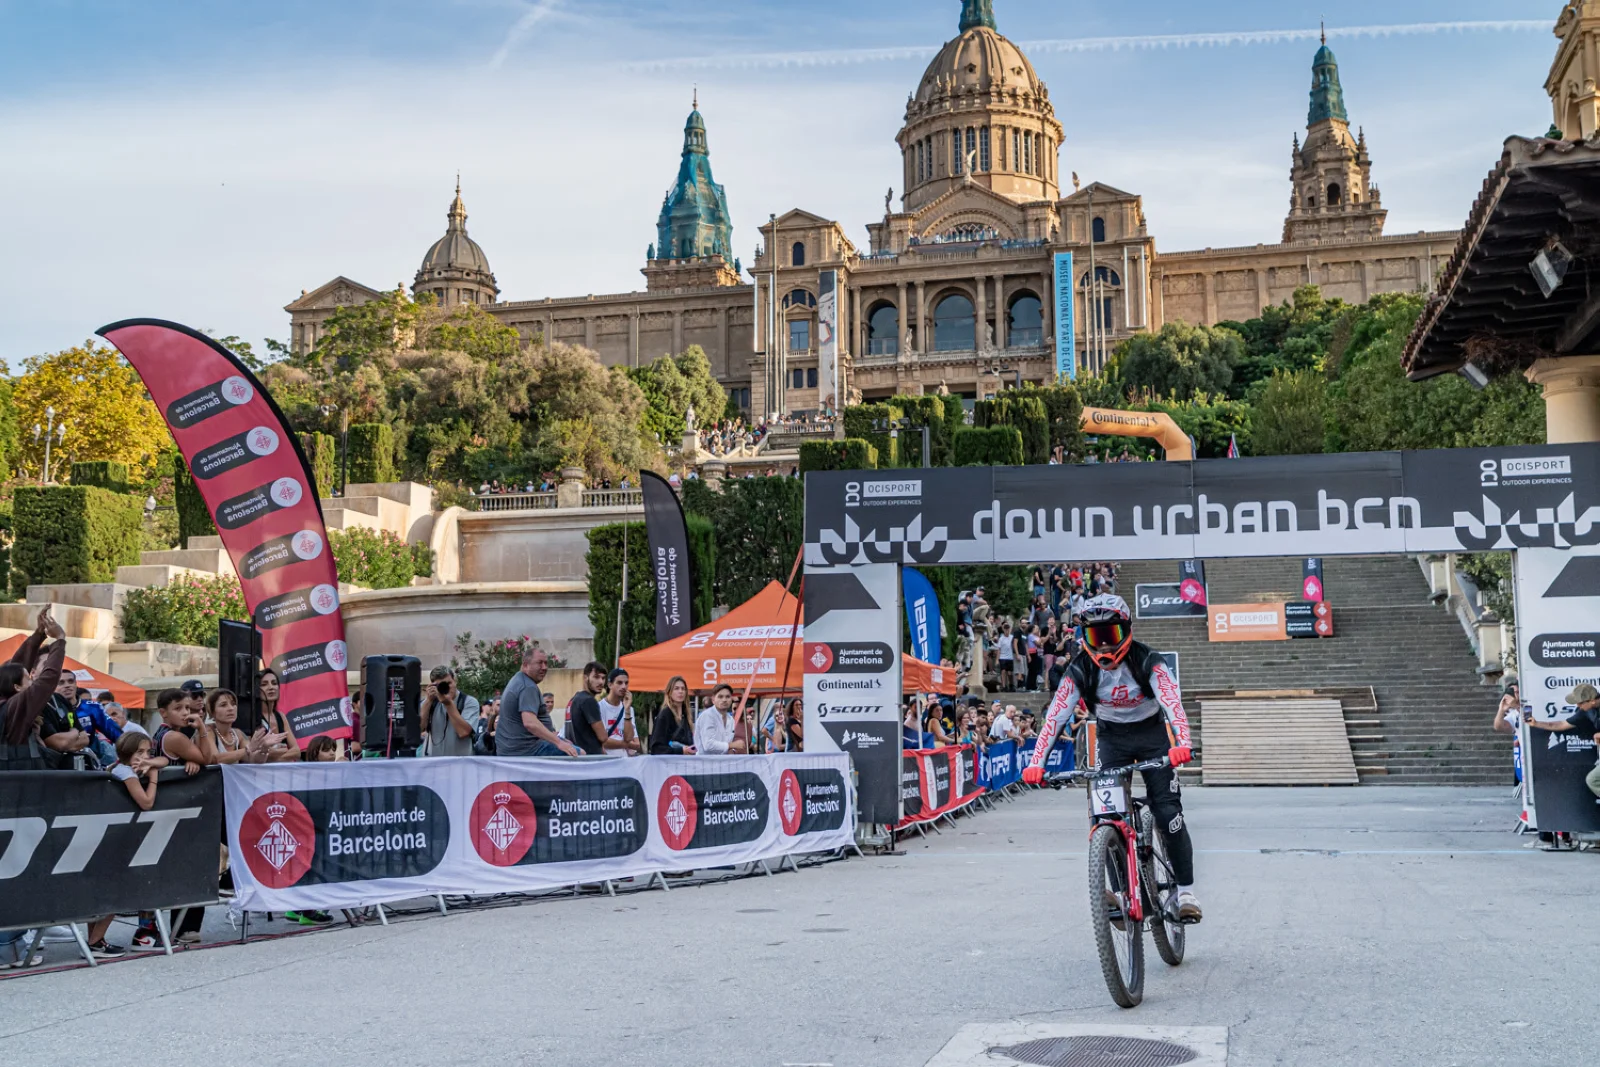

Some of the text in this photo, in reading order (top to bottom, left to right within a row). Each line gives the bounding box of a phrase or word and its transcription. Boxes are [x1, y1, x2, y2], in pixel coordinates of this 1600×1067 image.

[1059, 260, 1068, 283] MUSEU
[1060, 286, 1069, 321] NACIONAL
[1061, 347, 1071, 356] DE
[1092, 411, 1150, 427] Continental
[1506, 460, 1565, 471] OCISPORT
[867, 483, 917, 493] OCISPORT
[1531, 477, 1573, 485] EXPERIENCES
[972, 499, 1114, 540] down
[1317, 488, 1422, 530] bcn
[1542, 640, 1584, 649] Ajuntament
[1542, 648, 1596, 658] Barcelona
[724, 661, 771, 671] OCISPORT
[839, 656, 883, 665] Barcelona
[817, 679, 873, 692] Continental
[830, 705, 884, 714] SCOTT
[704, 787, 756, 807] Ajuntament de
[1103, 790, 1112, 804] 2
[548, 795, 634, 816] Ajuntament de
[328, 806, 426, 831] Ajuntament de
[703, 805, 760, 825] Barcelona
[548, 815, 635, 838] Barcelona
[329, 830, 427, 856] Barcelona
